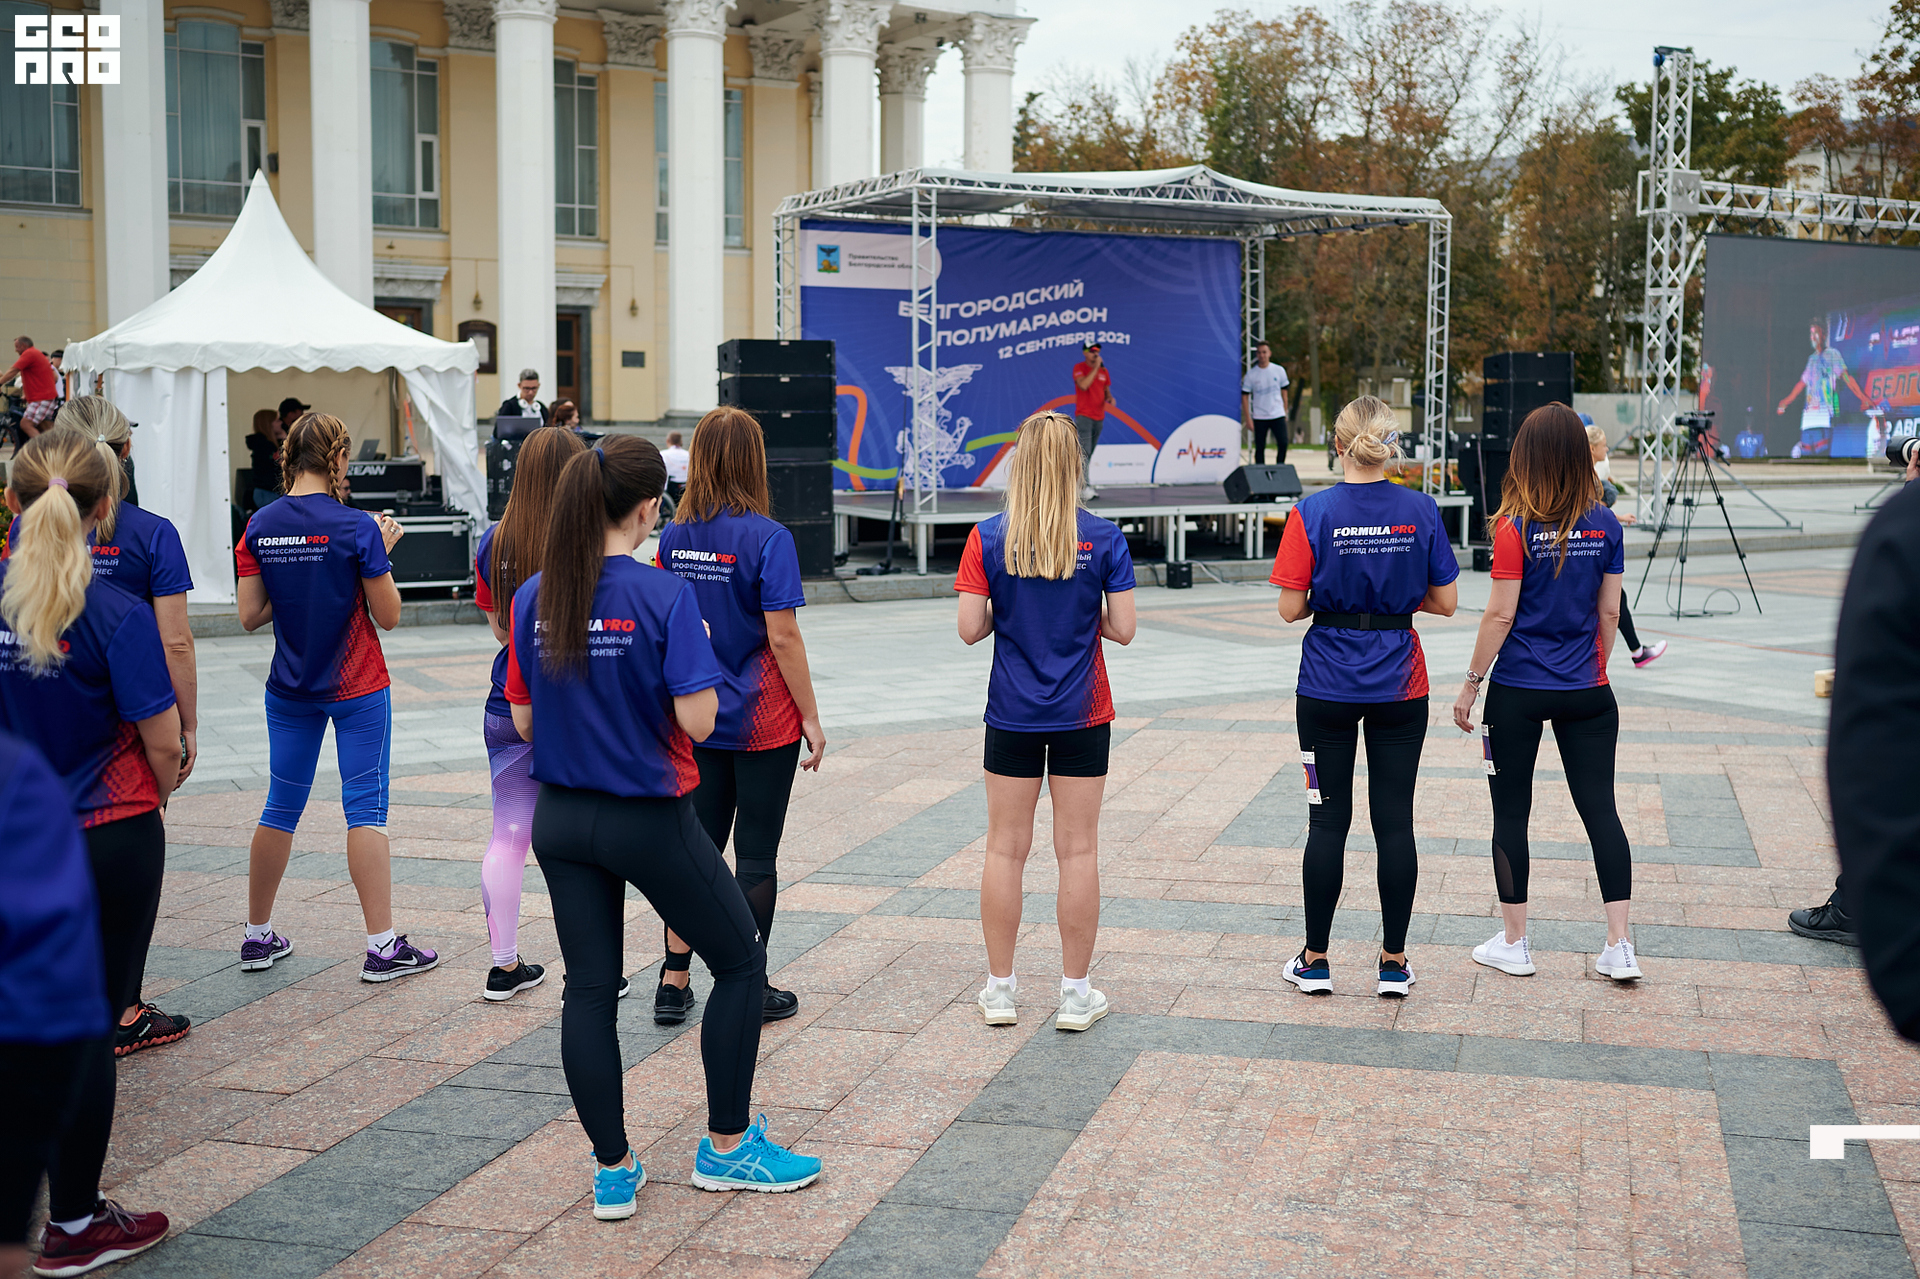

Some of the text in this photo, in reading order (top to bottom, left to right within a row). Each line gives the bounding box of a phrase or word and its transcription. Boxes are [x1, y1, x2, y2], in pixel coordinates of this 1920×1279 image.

[898, 279, 1084, 320] БЕЛГОРОДСКИЙ
[936, 307, 1108, 347] ПОЛУМАРАФОН
[998, 331, 1130, 360] 12 СЕНТЯБРЯ 2021
[1871, 369, 1920, 400] БЕЛГ
[1333, 525, 1416, 538] FORMULAPRO
[1533, 530, 1605, 542] FORLAPRO
[257, 535, 330, 547] FORMULAPRO
[1333, 536, 1415, 547] ПРОФЕССИОНАЛЬНЫЙ
[258, 546, 329, 555] ПРОФЕССИОНАЛЬНЫЙ
[1339, 547, 1367, 555] ВЗГЛЯД
[1380, 545, 1411, 553] ФИТНЕС
[262, 556, 287, 564] ВЗГЛЯД
[671, 549, 737, 565] FORMULAPRO
[697, 573, 707, 581] НА
[590, 647, 626, 657] ФИТНЕС
